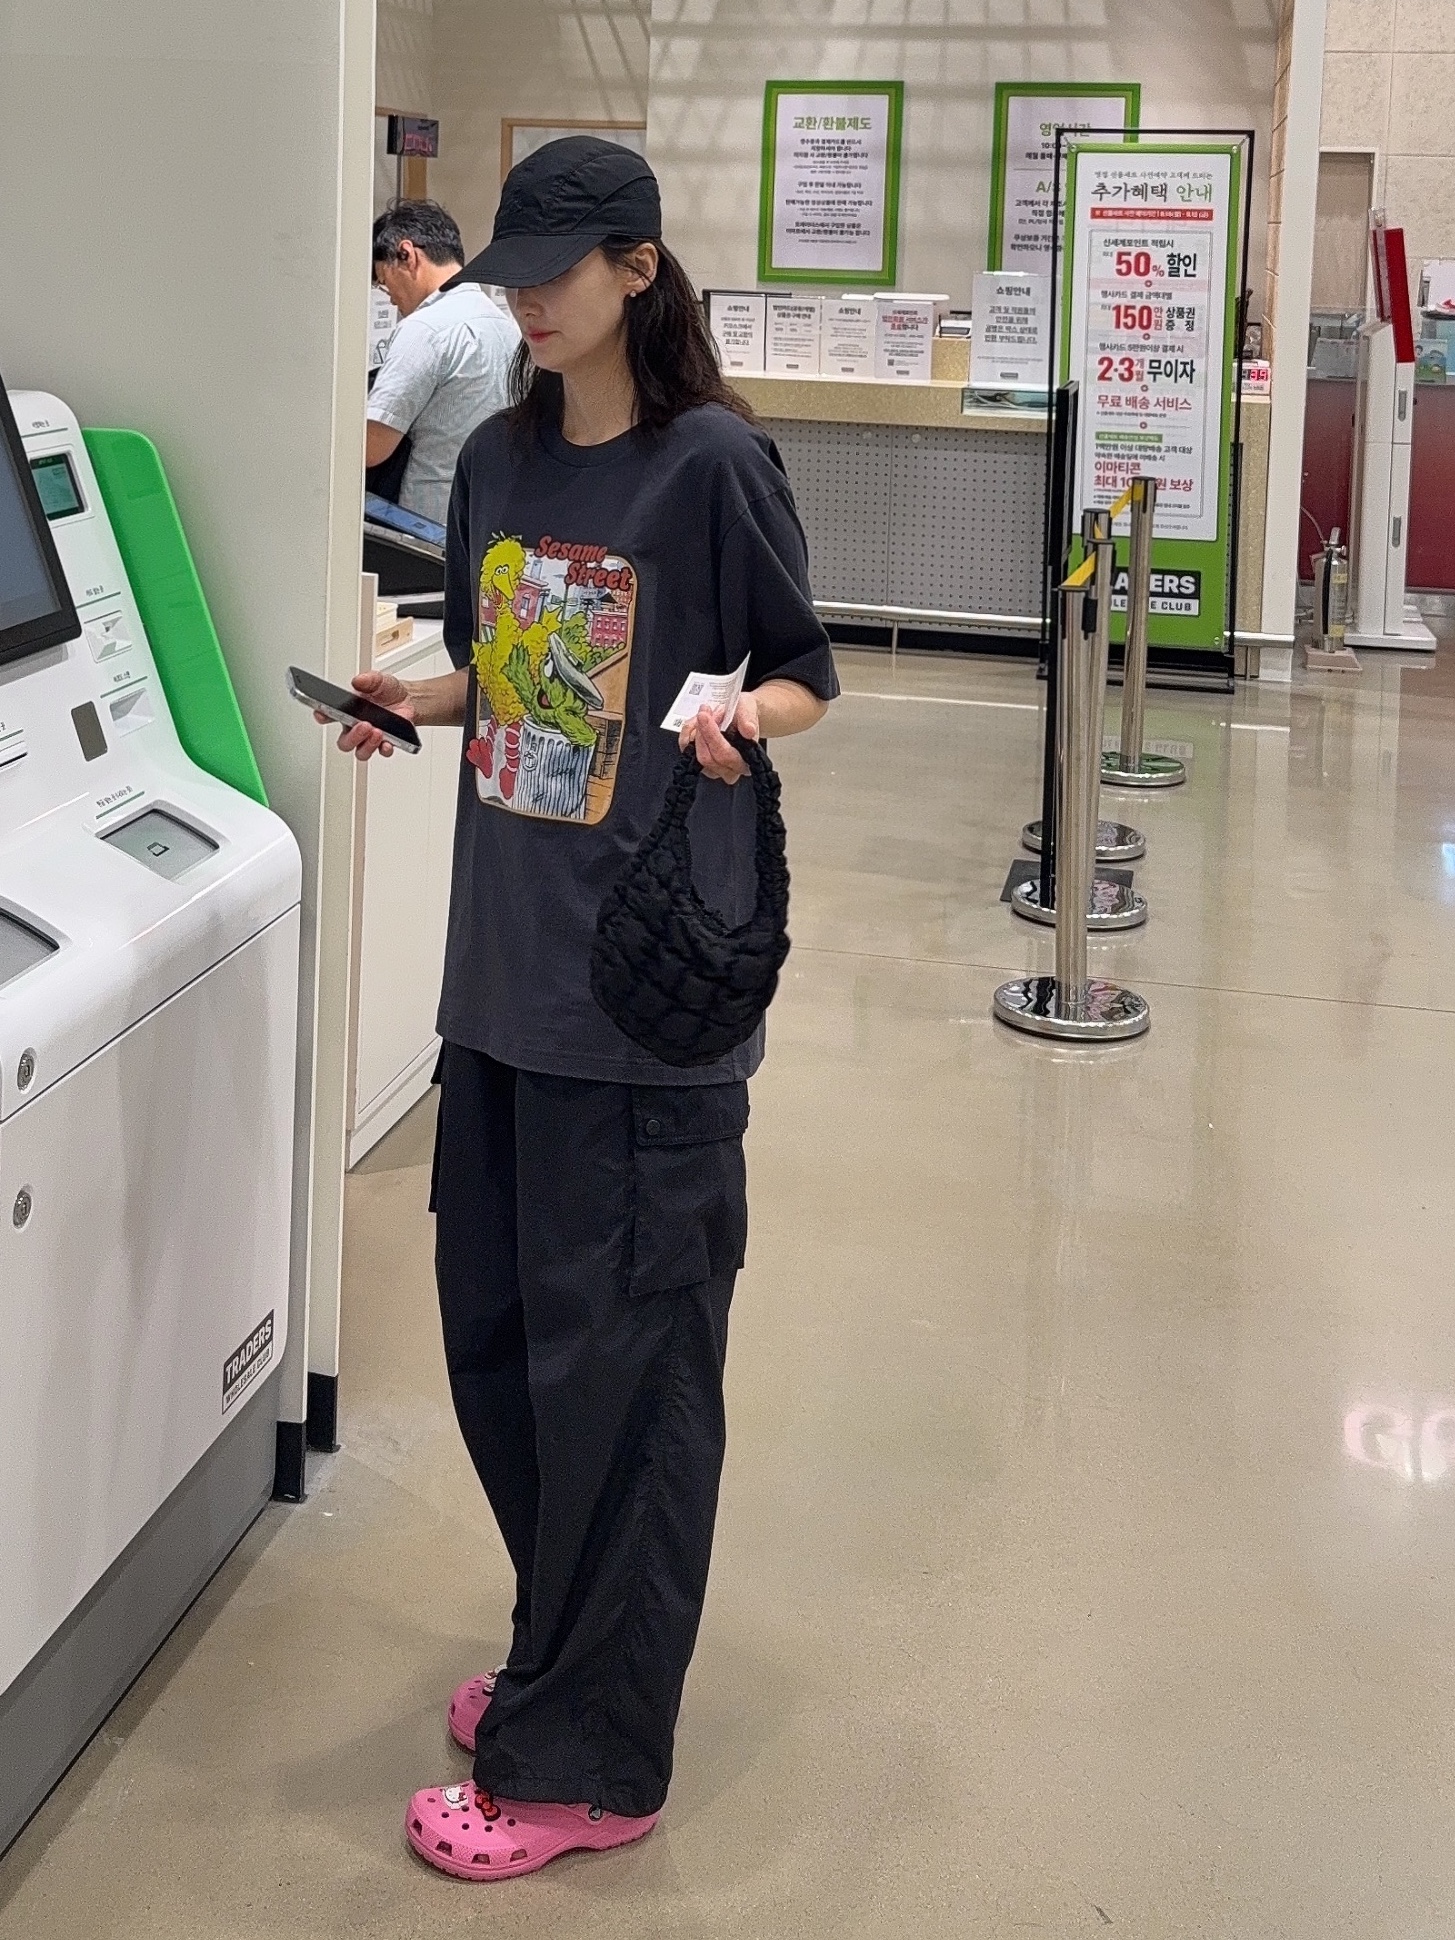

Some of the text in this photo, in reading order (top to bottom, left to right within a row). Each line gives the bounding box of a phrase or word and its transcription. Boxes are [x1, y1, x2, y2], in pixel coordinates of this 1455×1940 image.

[793, 116, 872, 131] 교환/환불제도
[1091, 182, 1212, 203] 추가혜택 안내
[1103, 239, 1174, 248] 신세계포인트 적립시
[1166, 252, 1197, 278] 할인
[996, 286, 1031, 296] 쇼핑안내
[1101, 290, 1128, 298] 행사카드
[1112, 305, 1152, 330] 150
[1165, 306, 1195, 319] 상품권
[1099, 342, 1126, 352] 행사카드
[1176, 345, 1184, 354] 시
[1147, 359, 1196, 384] 무이자
[1097, 395, 1193, 411] 무료 배송 서비스
[1163, 446, 1177, 454] 고객
[1178, 446, 1193, 454] 대상
[1094, 461, 1141, 475] 이마티콘
[1094, 475, 1117, 488] 최대
[1168, 478, 1194, 492] 보상
[534, 535, 608, 564] Sesame
[563, 560, 633, 592] Street
[1161, 601, 1192, 612] CLUB
[225, 1319, 273, 1385] TRADERS
